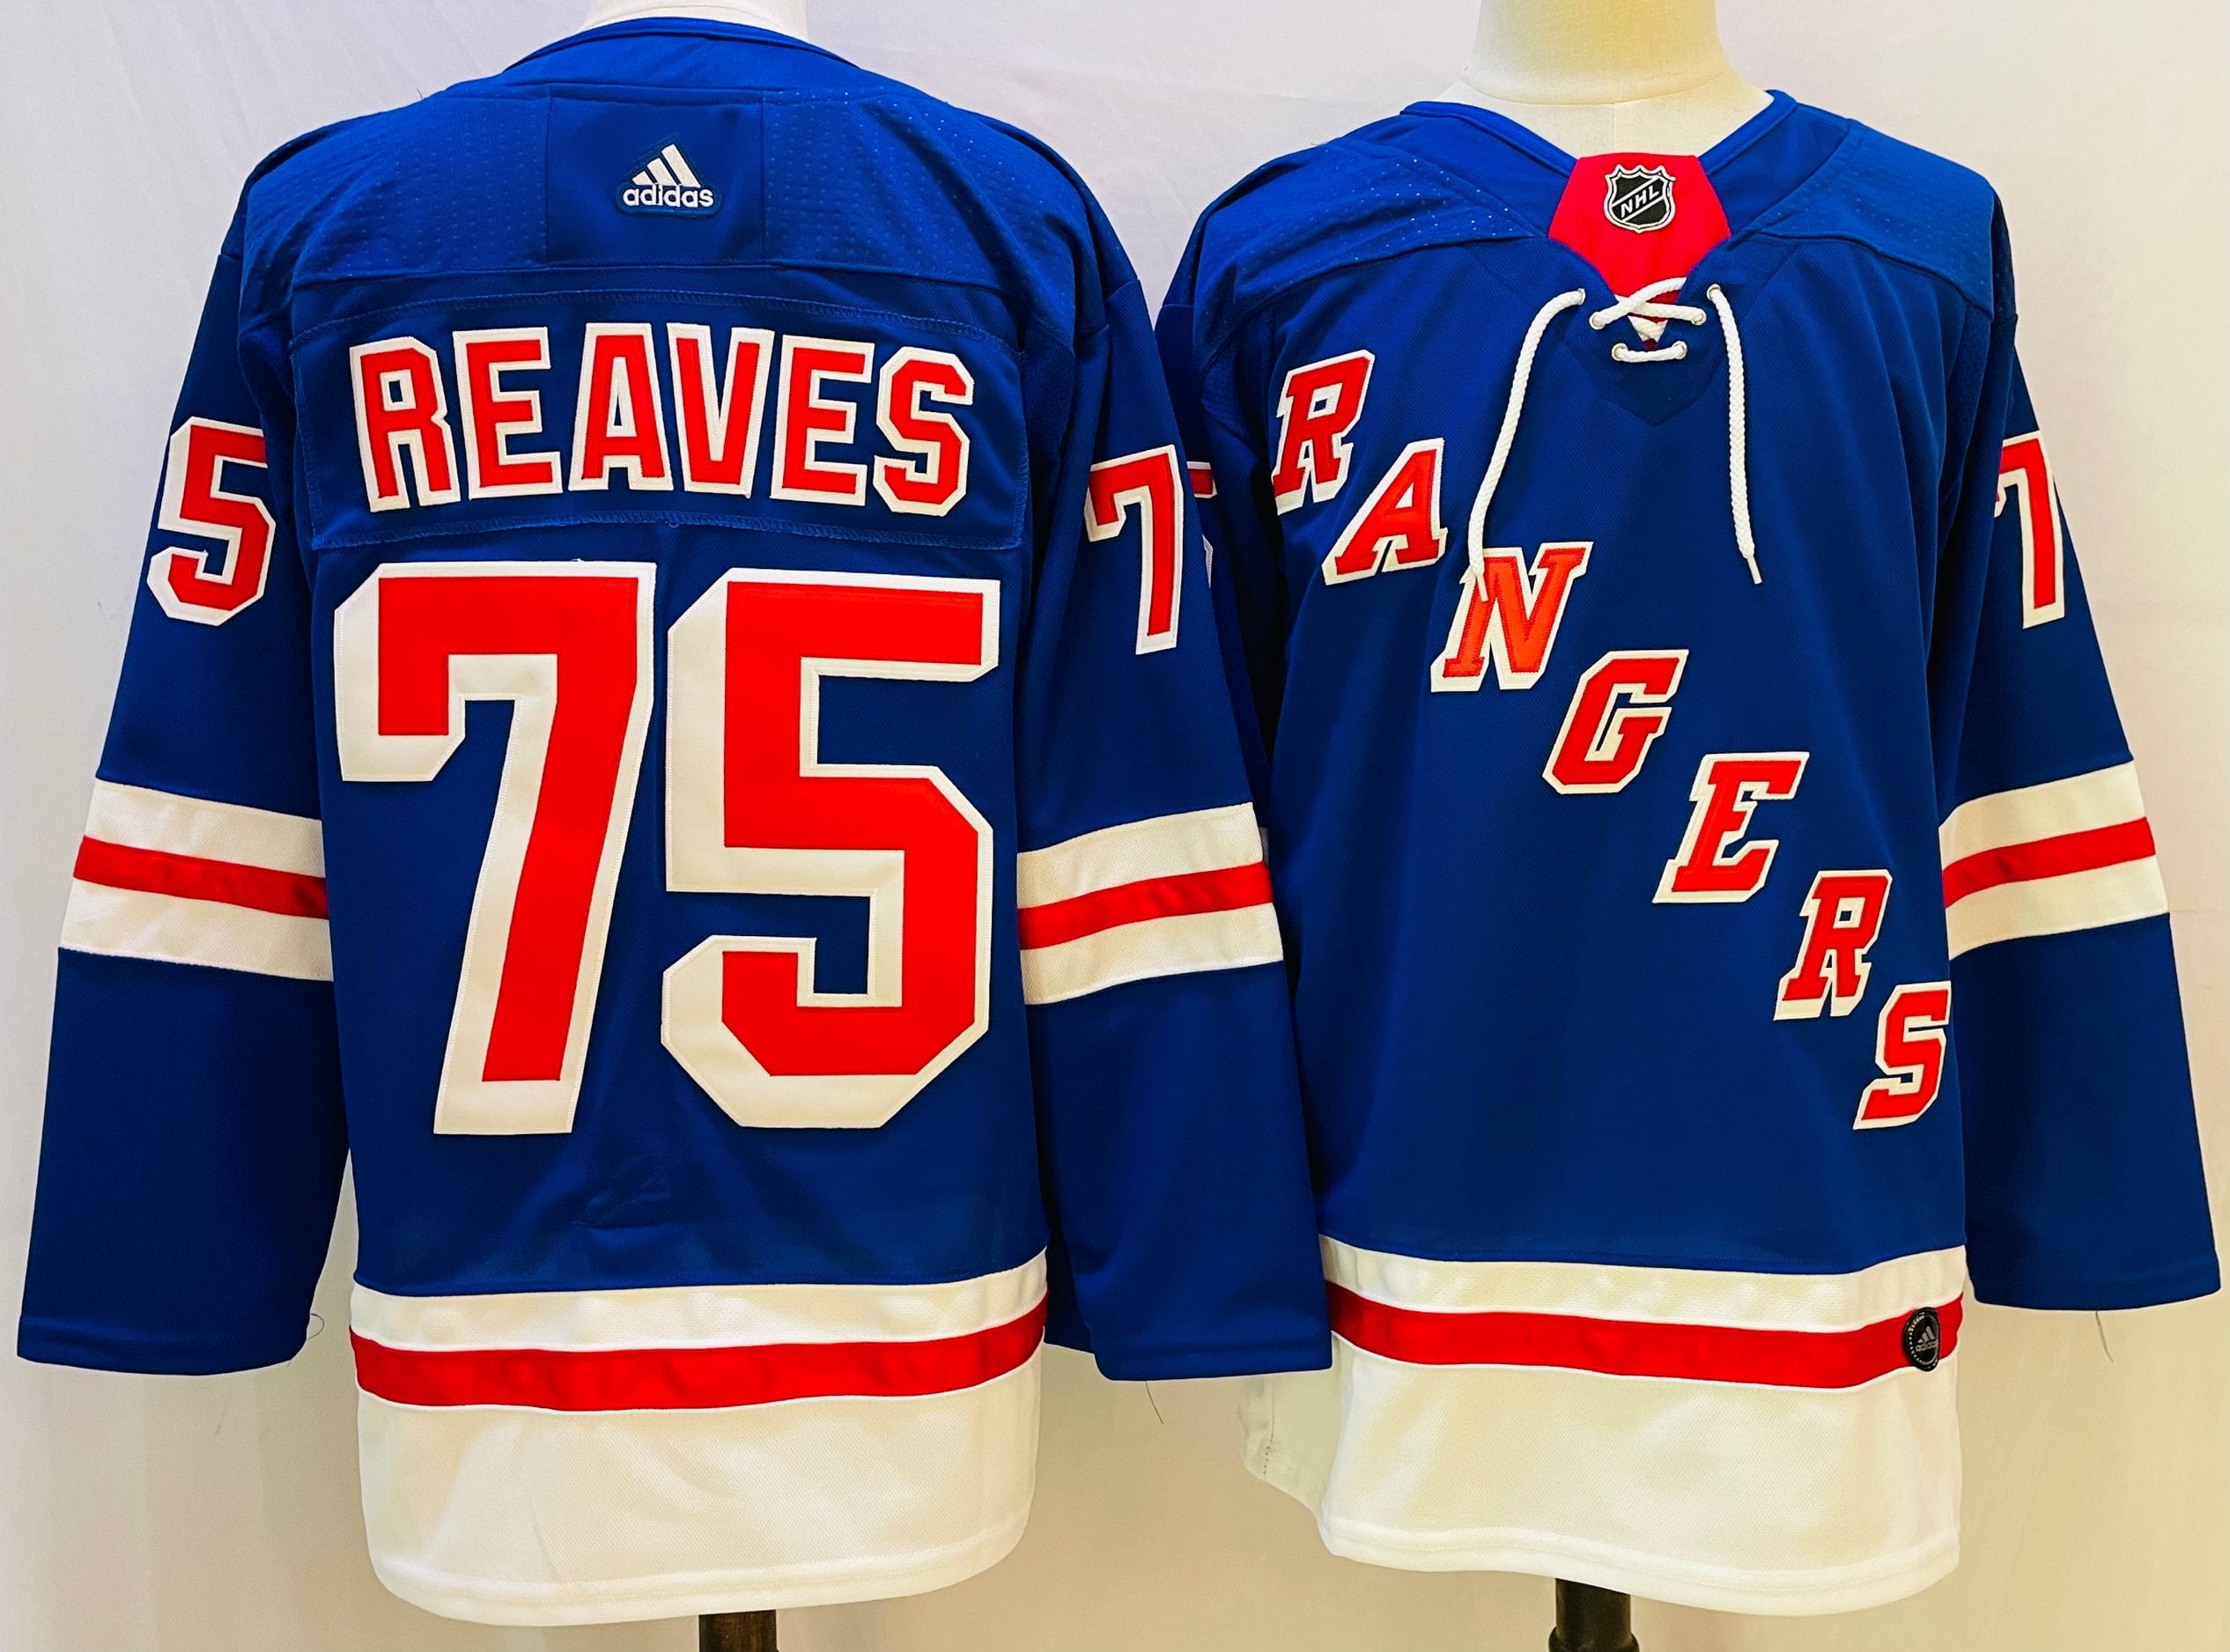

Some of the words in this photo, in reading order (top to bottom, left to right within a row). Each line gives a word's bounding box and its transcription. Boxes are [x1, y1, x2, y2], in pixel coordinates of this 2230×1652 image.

[623, 182, 714, 208] adidas
[1621, 184, 1660, 218] NHL
[146, 416, 277, 626] 5
[350, 322, 973, 516] REAVES
[1084, 444, 1184, 655] 7
[1994, 430, 2065, 629] 7
[1273, 350, 1952, 1131] RANGERS
[334, 561, 1001, 1135] 75
